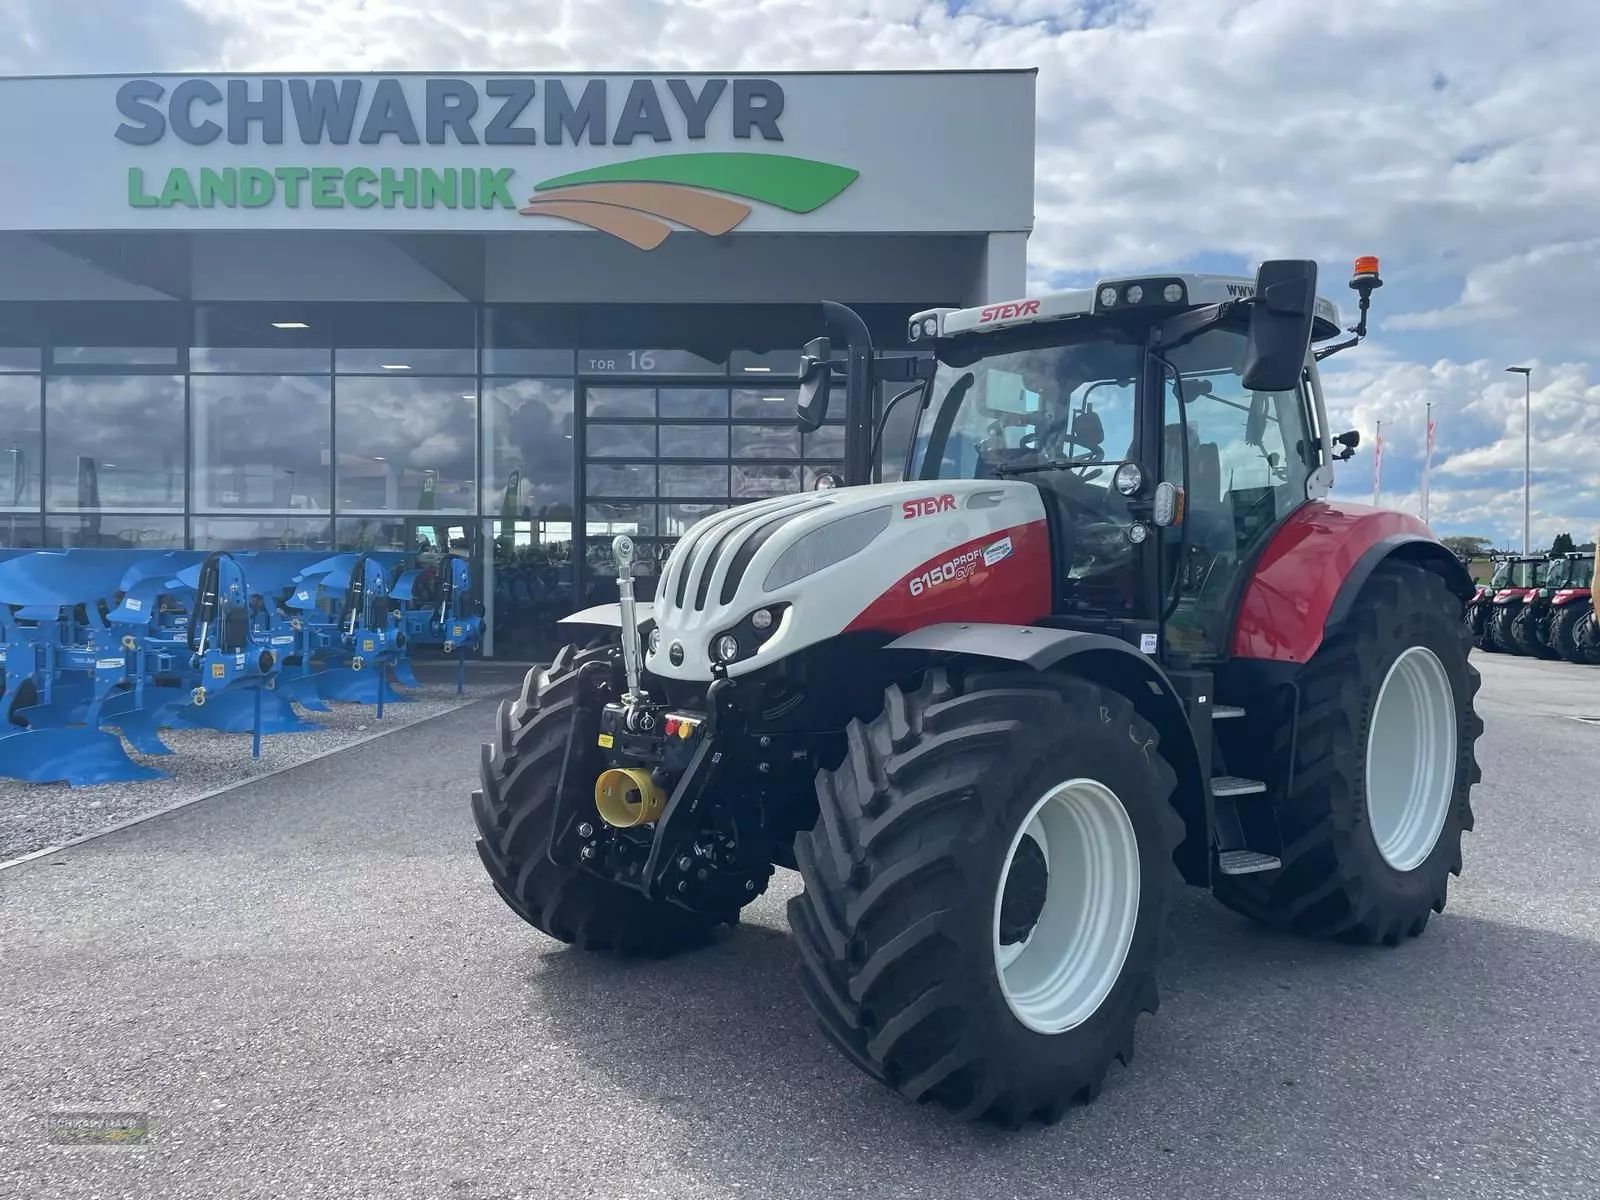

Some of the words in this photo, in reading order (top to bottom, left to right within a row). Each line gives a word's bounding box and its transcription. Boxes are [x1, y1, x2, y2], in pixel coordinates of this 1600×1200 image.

[114, 79, 785, 146] SCHWARZMAYR
[128, 167, 517, 209] LANDTECHNIK
[979, 300, 1041, 323] STEYR
[589, 359, 616, 370] TOR
[628, 350, 656, 370] 16
[902, 493, 957, 520] STEYR
[909, 561, 957, 597] 6150
[953, 548, 983, 568] PROFI
[955, 562, 977, 581] CVT
